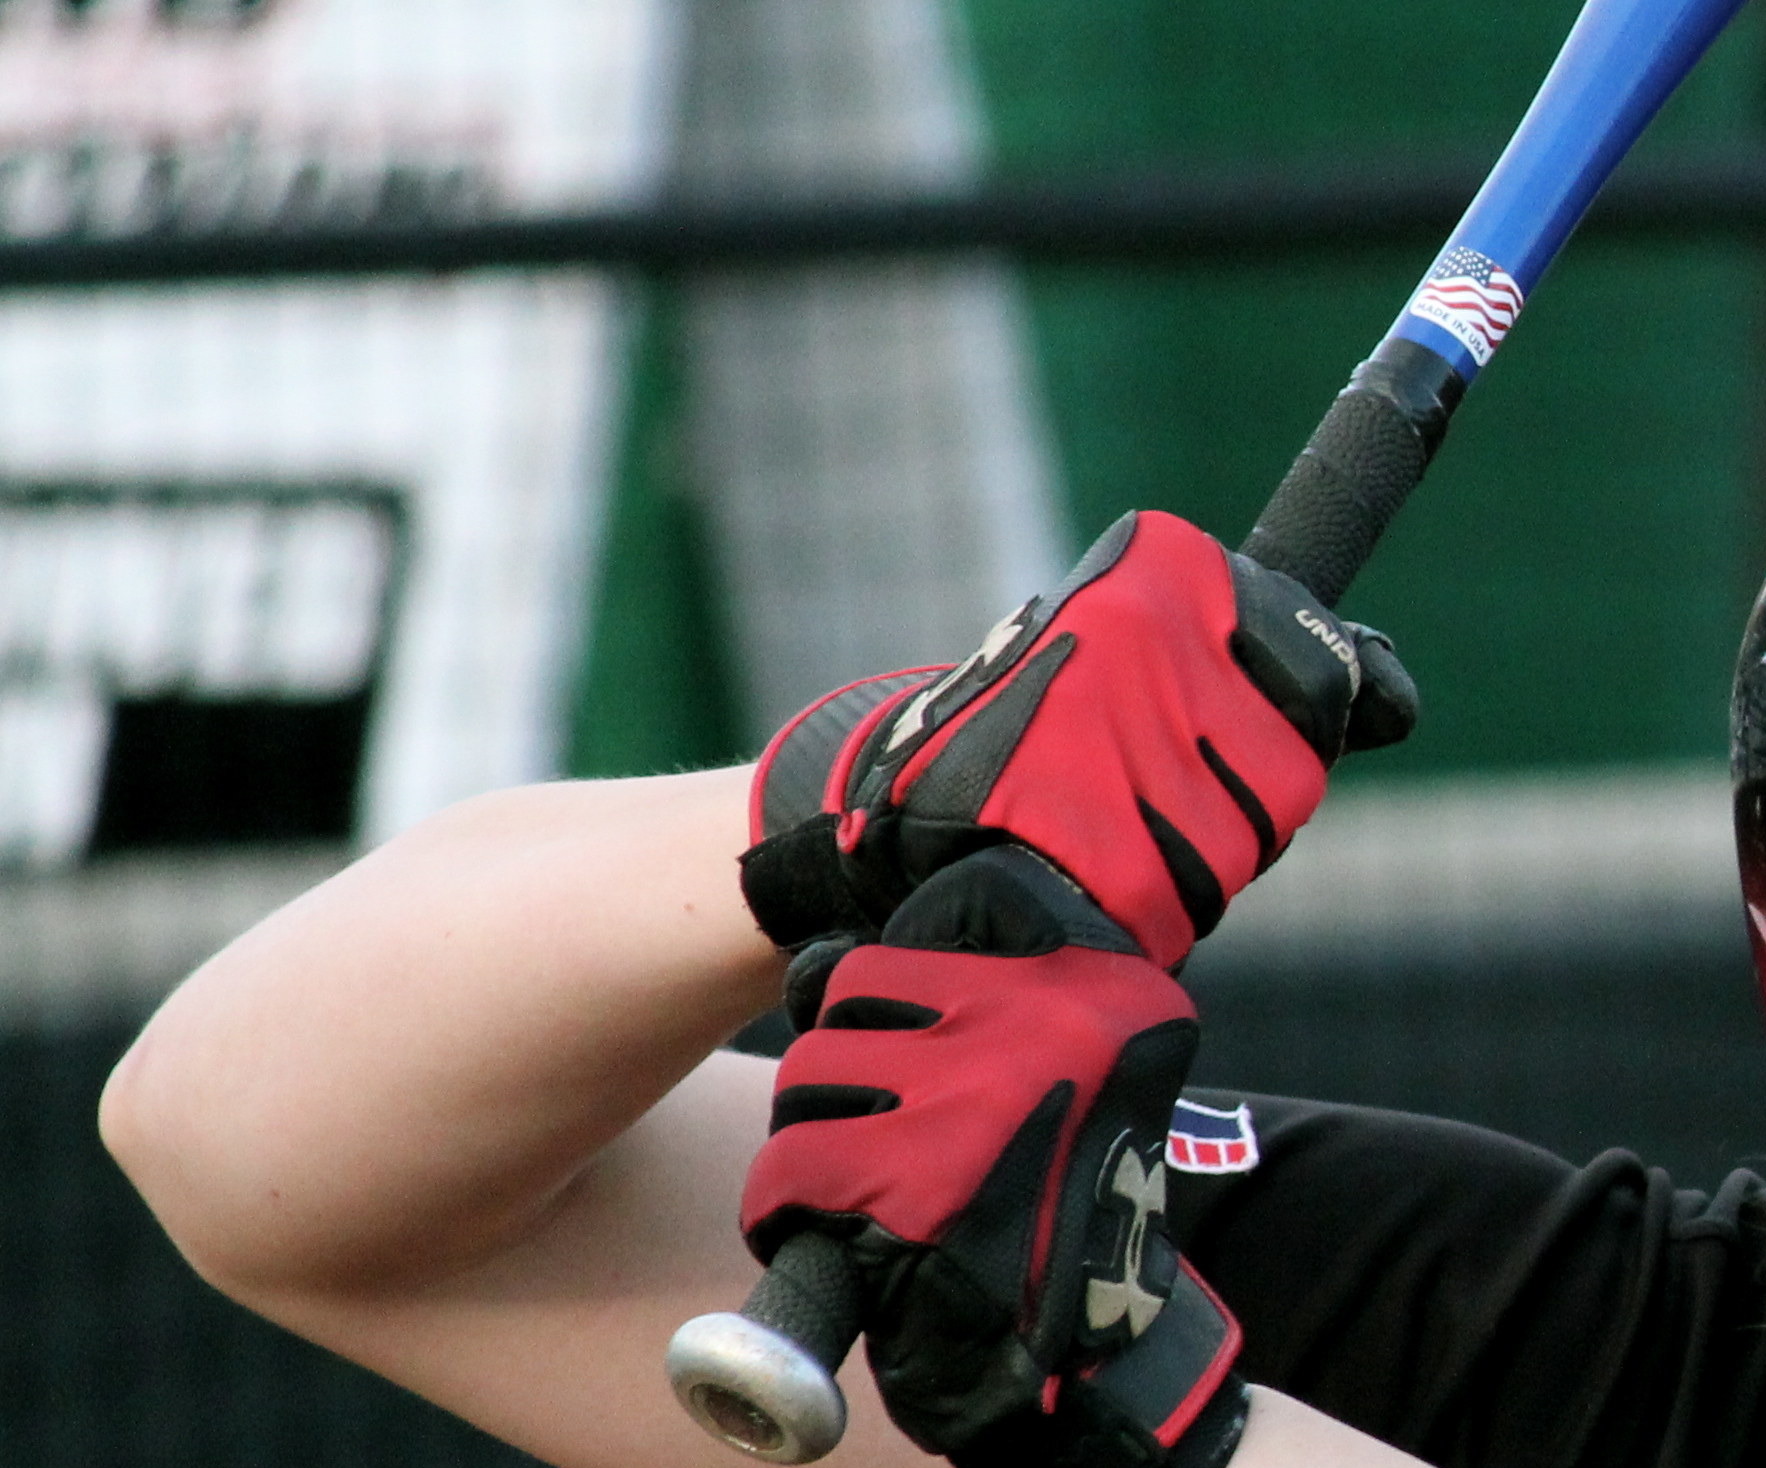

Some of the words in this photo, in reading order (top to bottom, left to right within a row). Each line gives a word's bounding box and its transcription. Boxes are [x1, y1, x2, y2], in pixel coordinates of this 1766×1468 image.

[1416, 302, 1451, 321] MADE
[1452, 320, 1468, 335] IN
[1468, 334, 1485, 358] USA
[1295, 609, 1359, 680] UND
